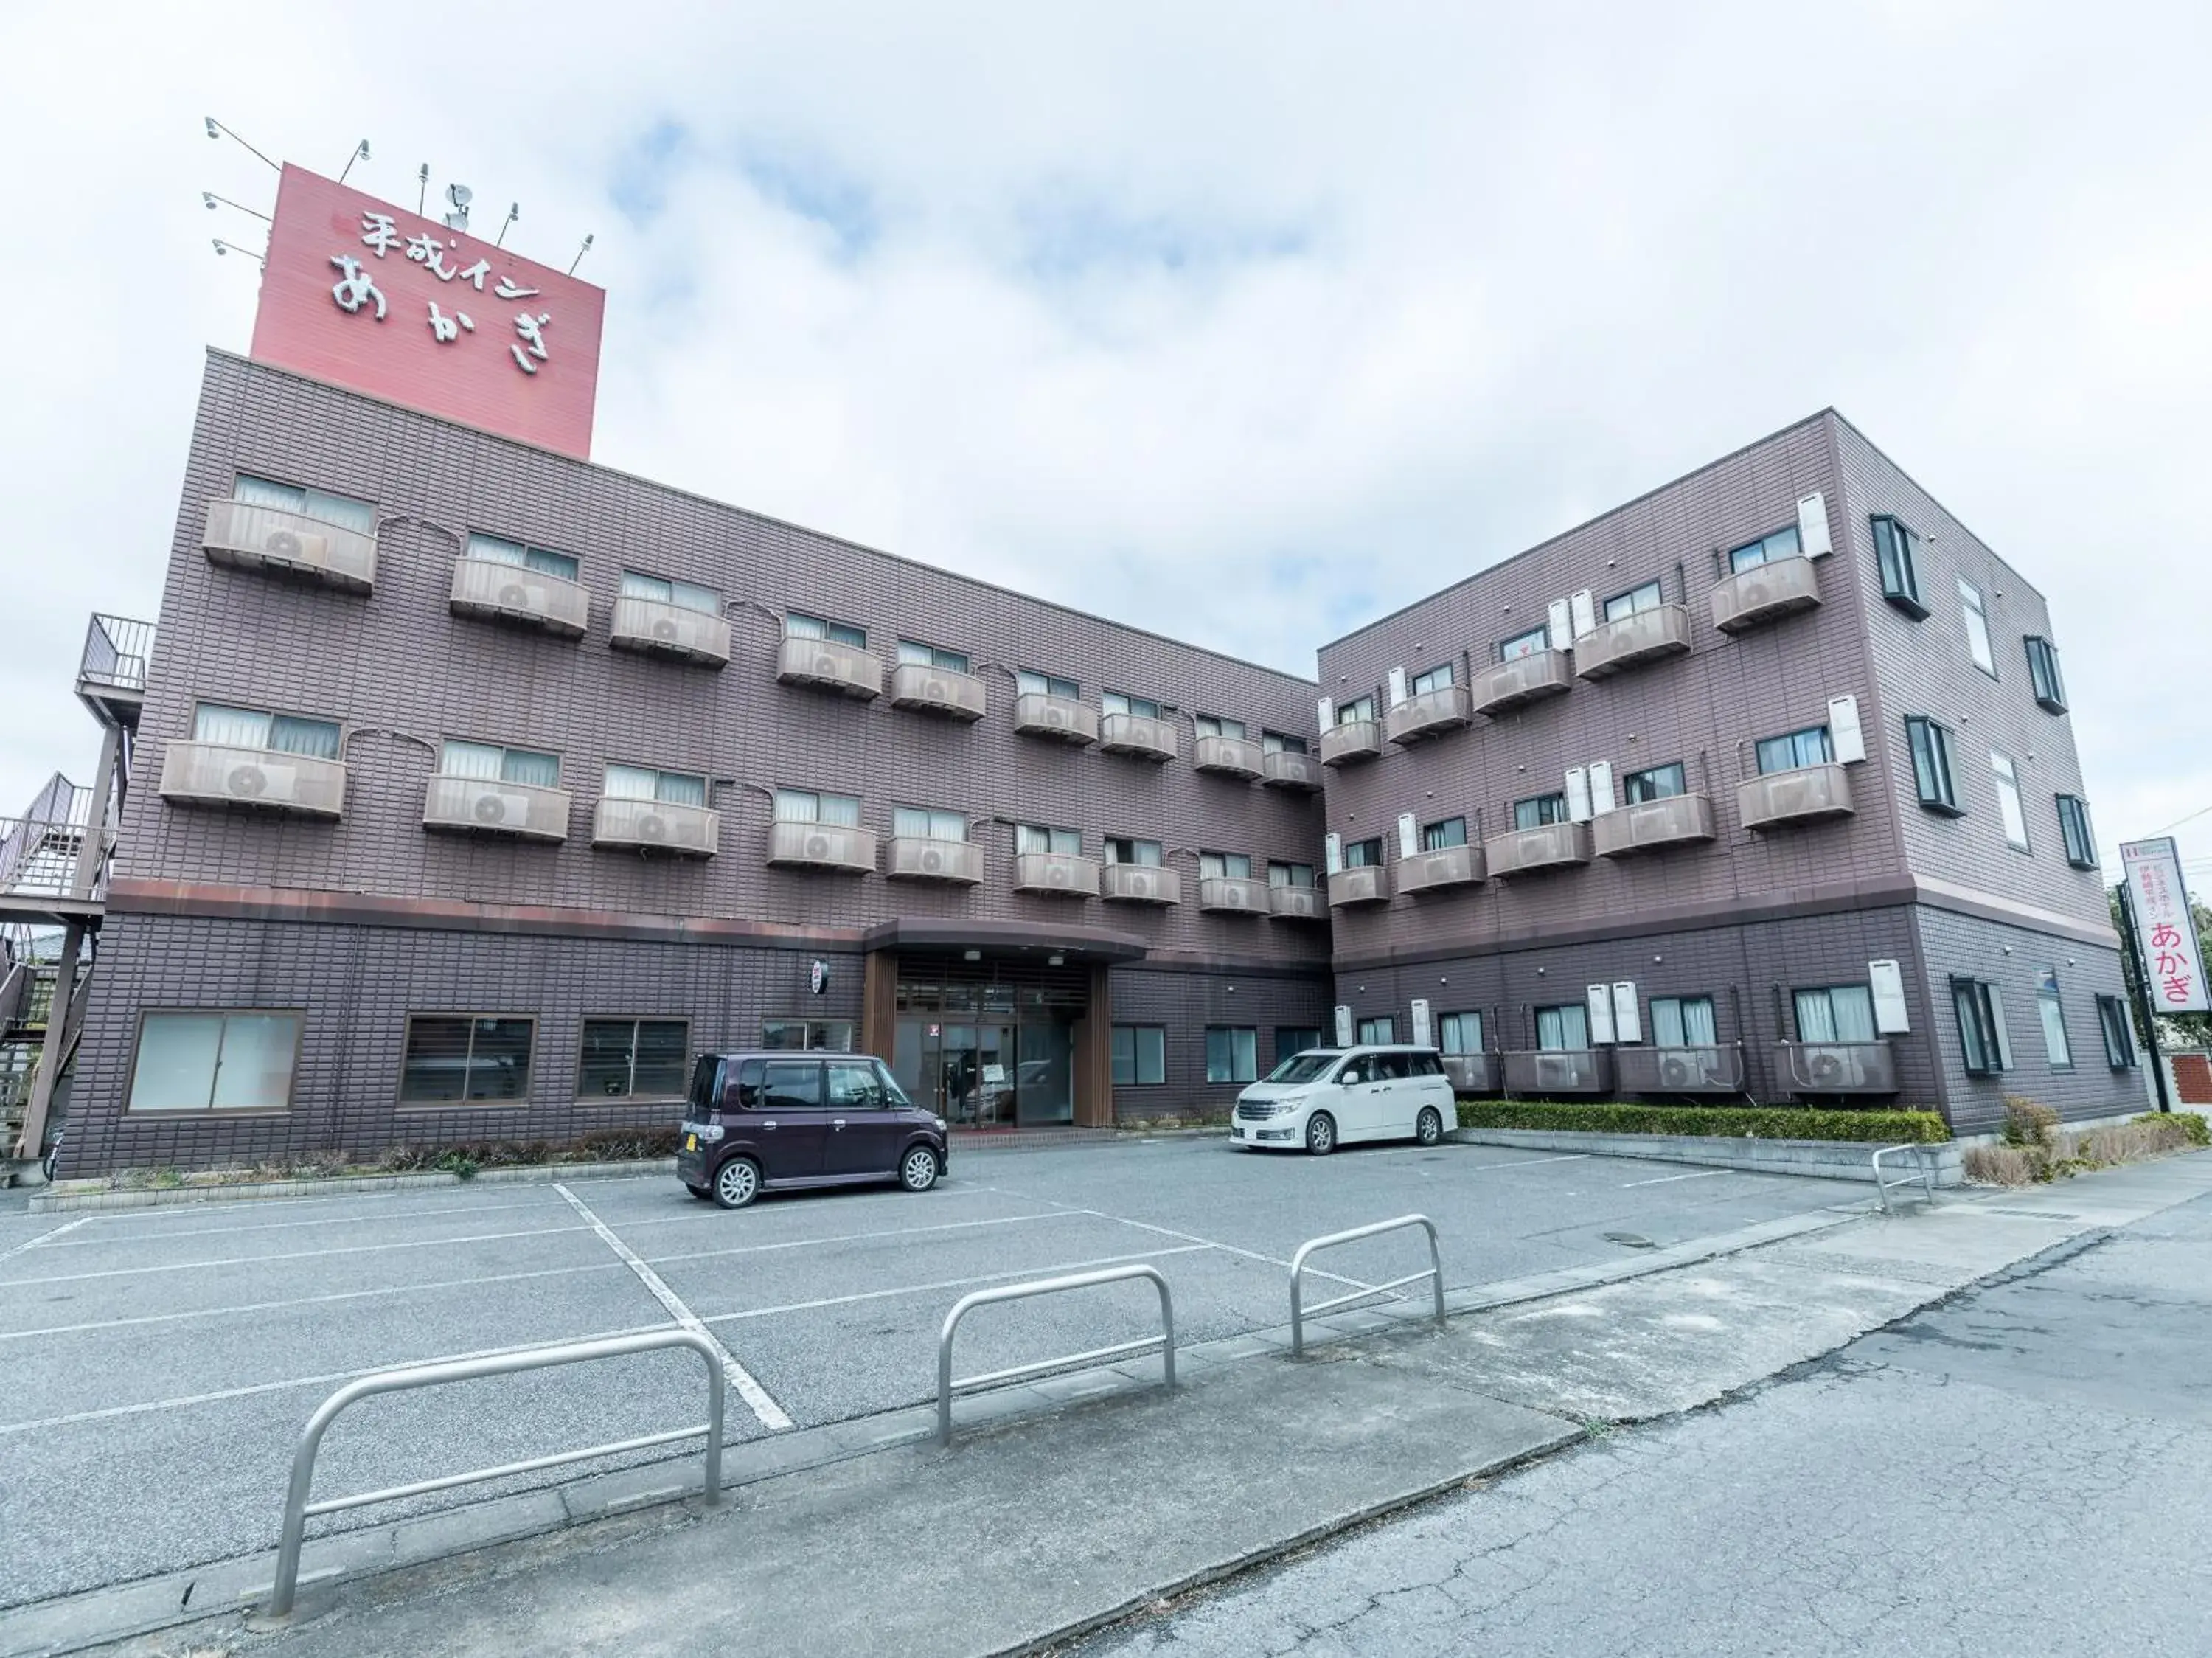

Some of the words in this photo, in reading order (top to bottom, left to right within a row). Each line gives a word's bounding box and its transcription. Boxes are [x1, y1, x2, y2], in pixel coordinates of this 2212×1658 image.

[361, 211, 540, 298] 平成イン
[330, 254, 551, 374] あかぎ
[2152, 923, 2192, 1003] あかぎ
